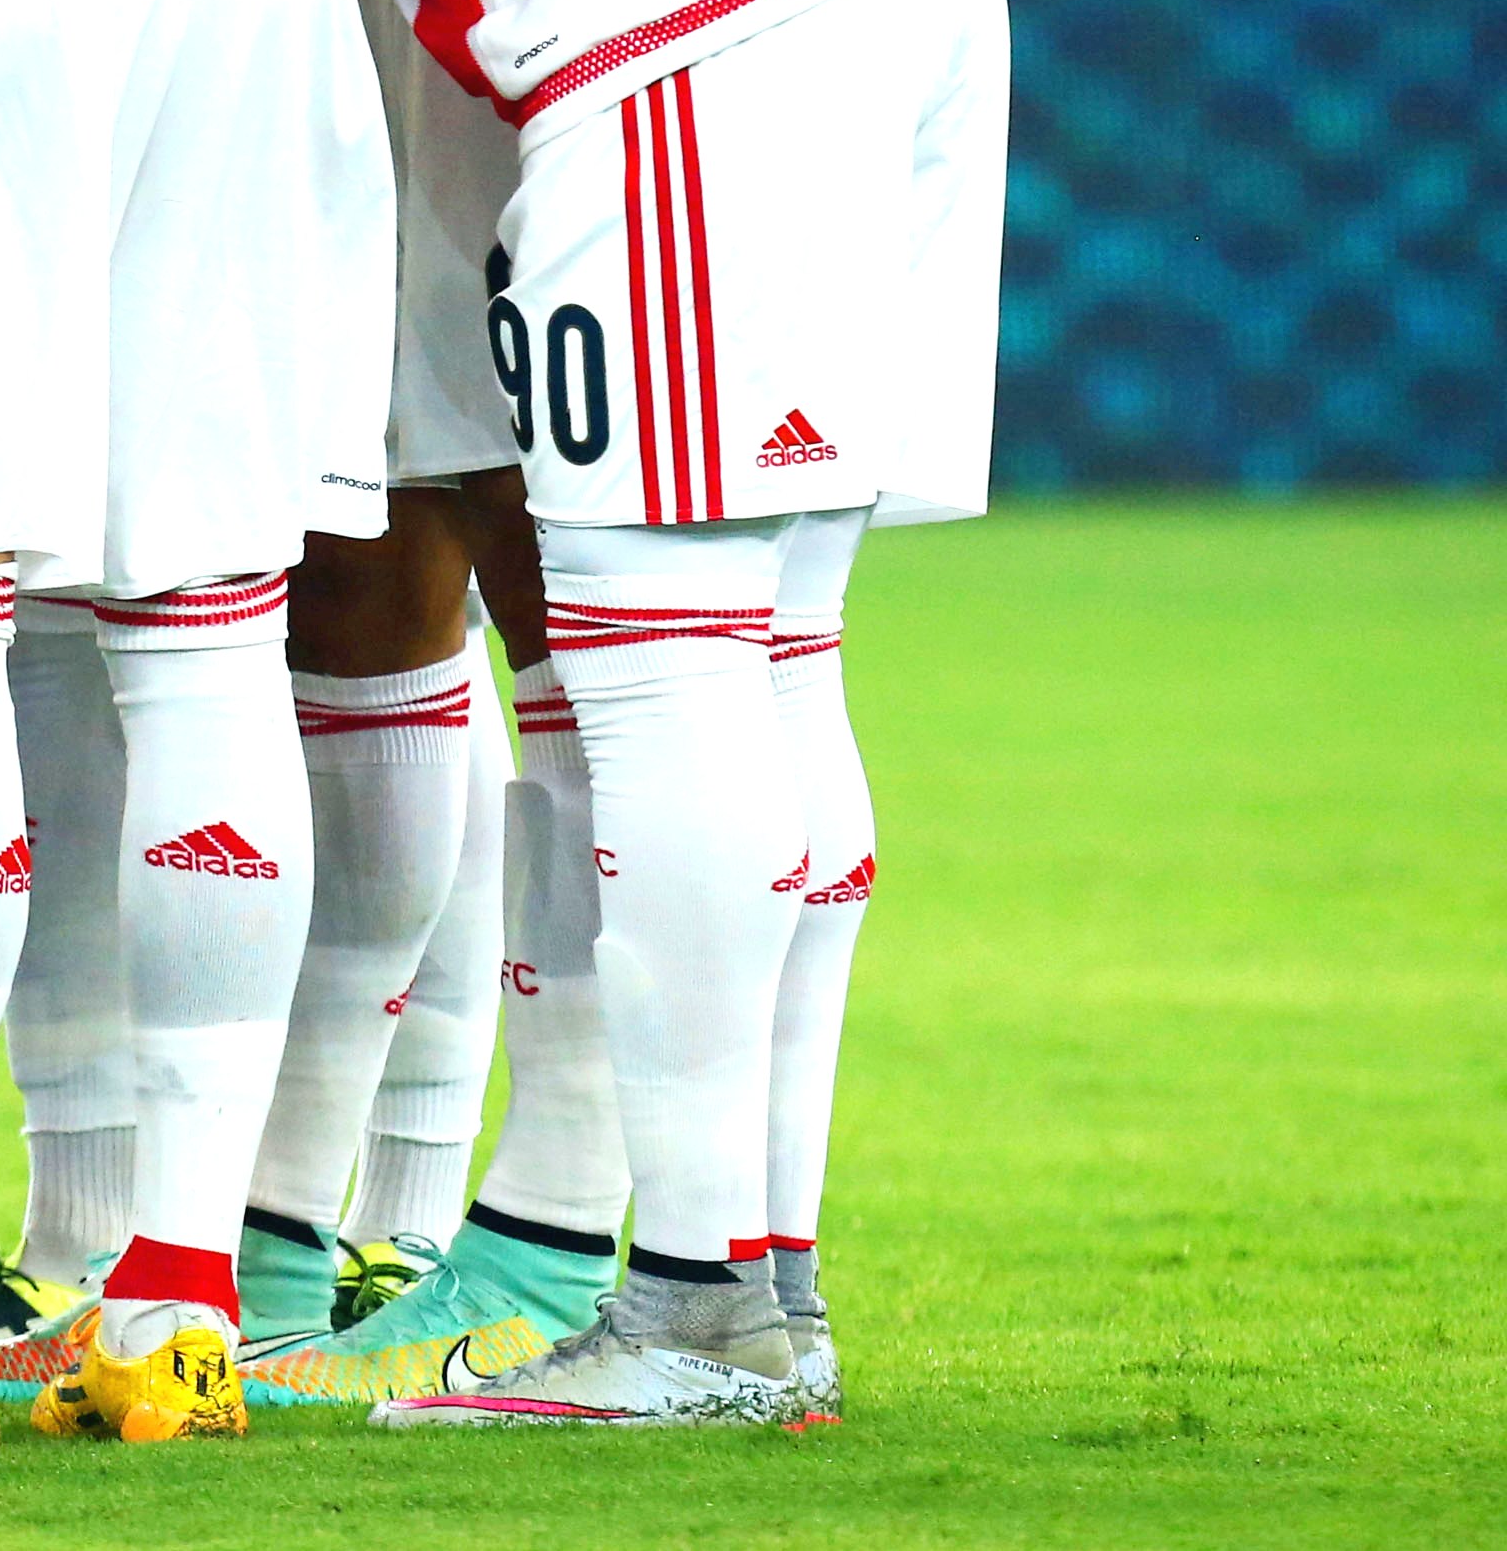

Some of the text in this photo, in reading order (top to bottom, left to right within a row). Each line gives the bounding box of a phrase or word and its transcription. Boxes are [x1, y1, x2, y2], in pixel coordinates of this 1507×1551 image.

[487, 296, 610, 466] 90
[756, 444, 838, 468] adidas
[321, 473, 382, 491] climacool
[144, 847, 280, 880] adidas
[678, 1355, 701, 1370] PIPE
